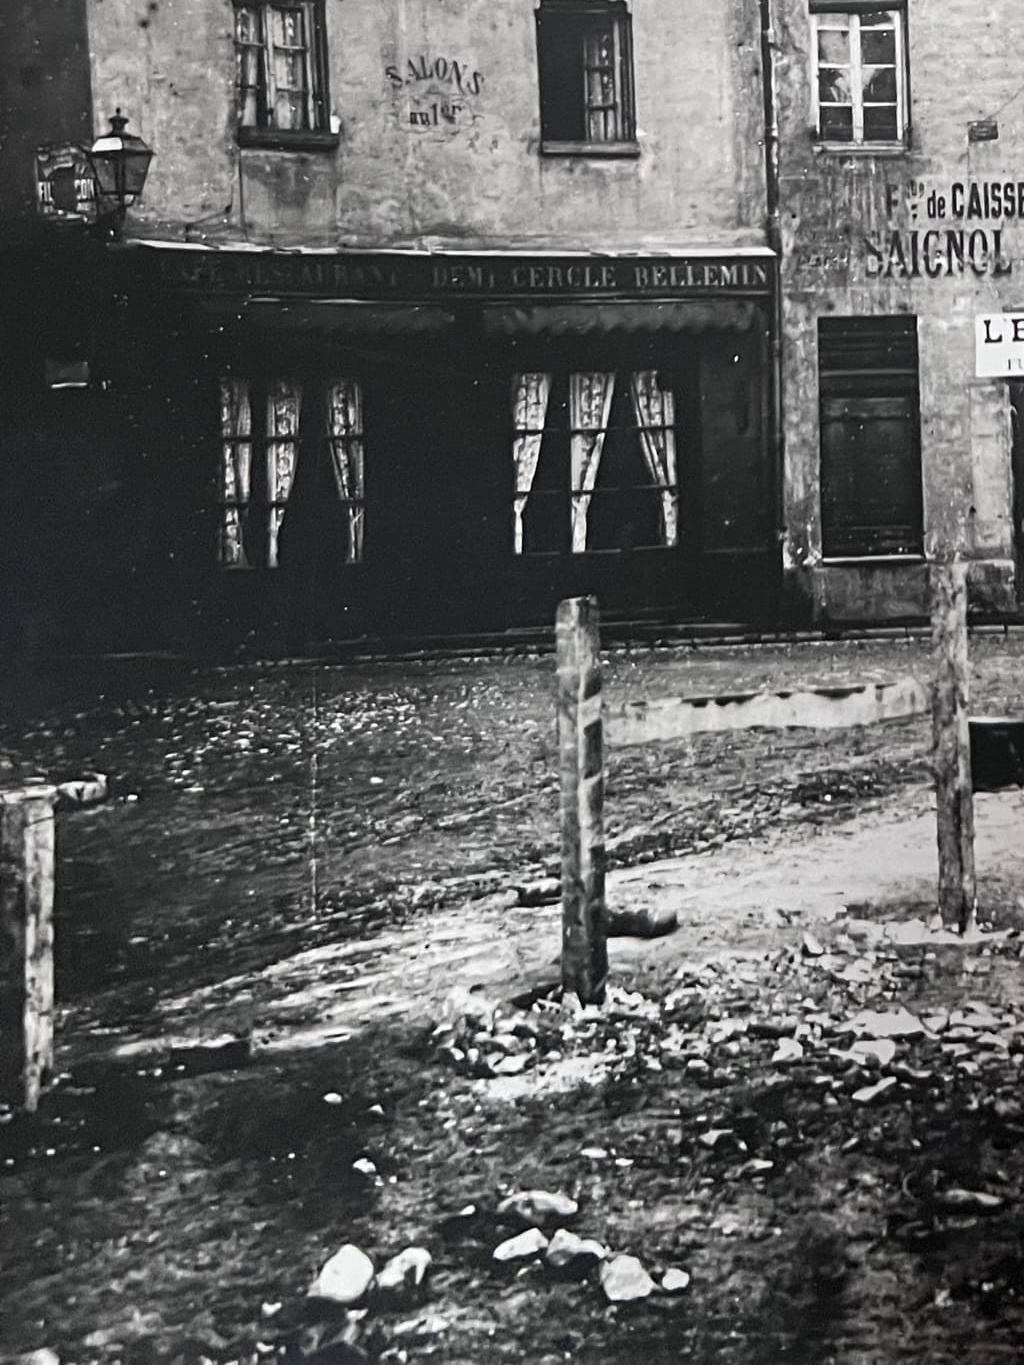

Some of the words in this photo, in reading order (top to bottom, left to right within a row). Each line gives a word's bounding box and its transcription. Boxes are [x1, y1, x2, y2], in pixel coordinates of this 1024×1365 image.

[385, 55, 485, 97] SALONS
[927, 189, 946, 219] de
[863, 228, 1013, 278] SAIGNOL
[511, 265, 617, 288] CERCLE
[633, 263, 768, 288] BELLEMIN
